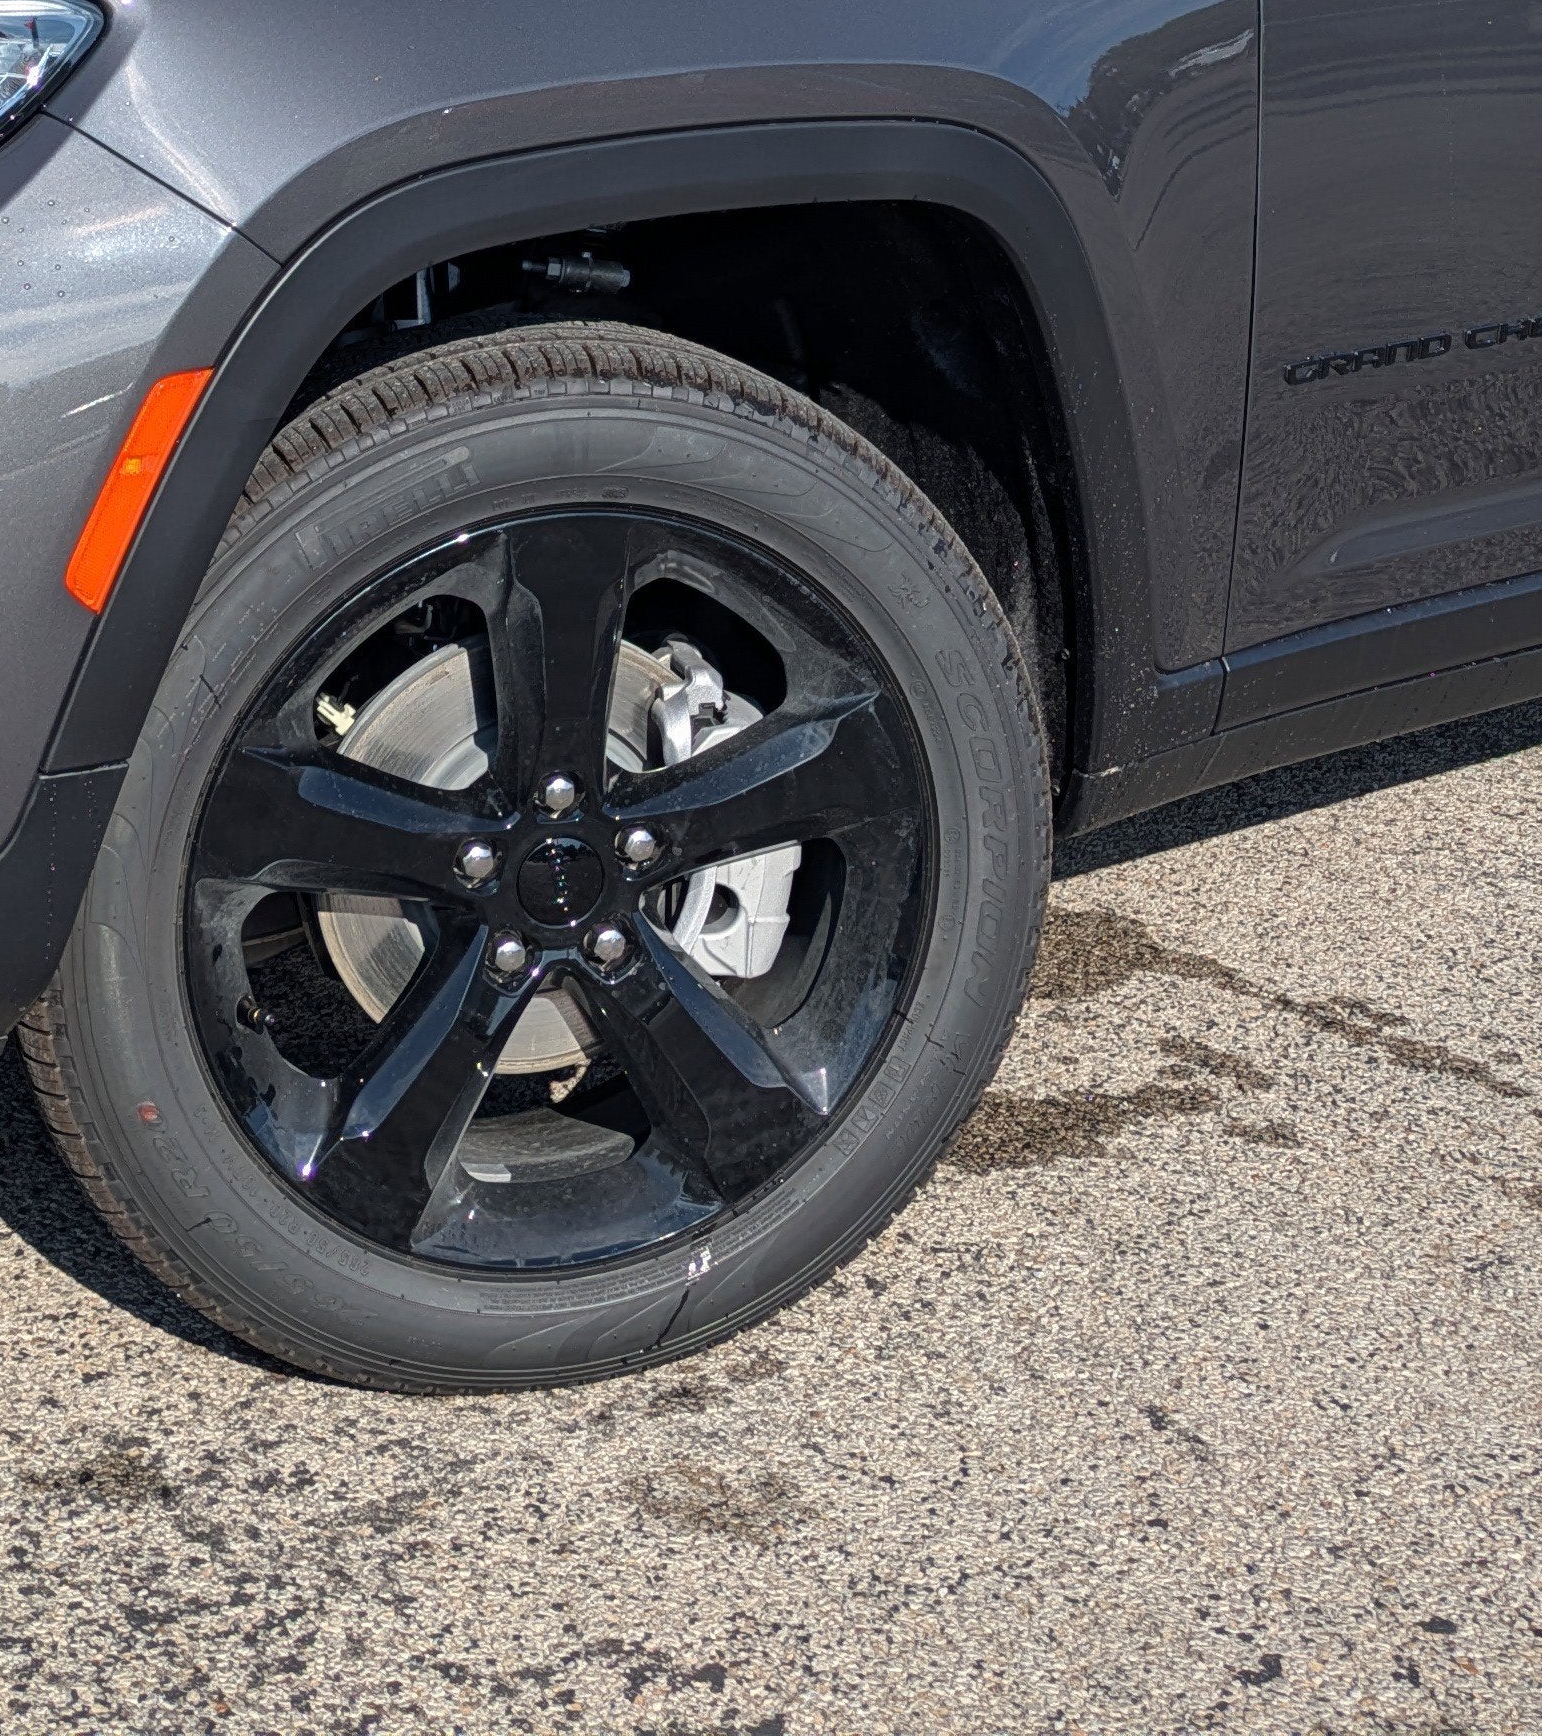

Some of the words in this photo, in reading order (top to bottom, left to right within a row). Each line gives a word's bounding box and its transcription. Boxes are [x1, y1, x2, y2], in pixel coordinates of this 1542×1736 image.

[1283, 330, 1452, 385] GRAND
[295, 446, 481, 570] PIRELLI
[935, 649, 1009, 1009] SCORPION
